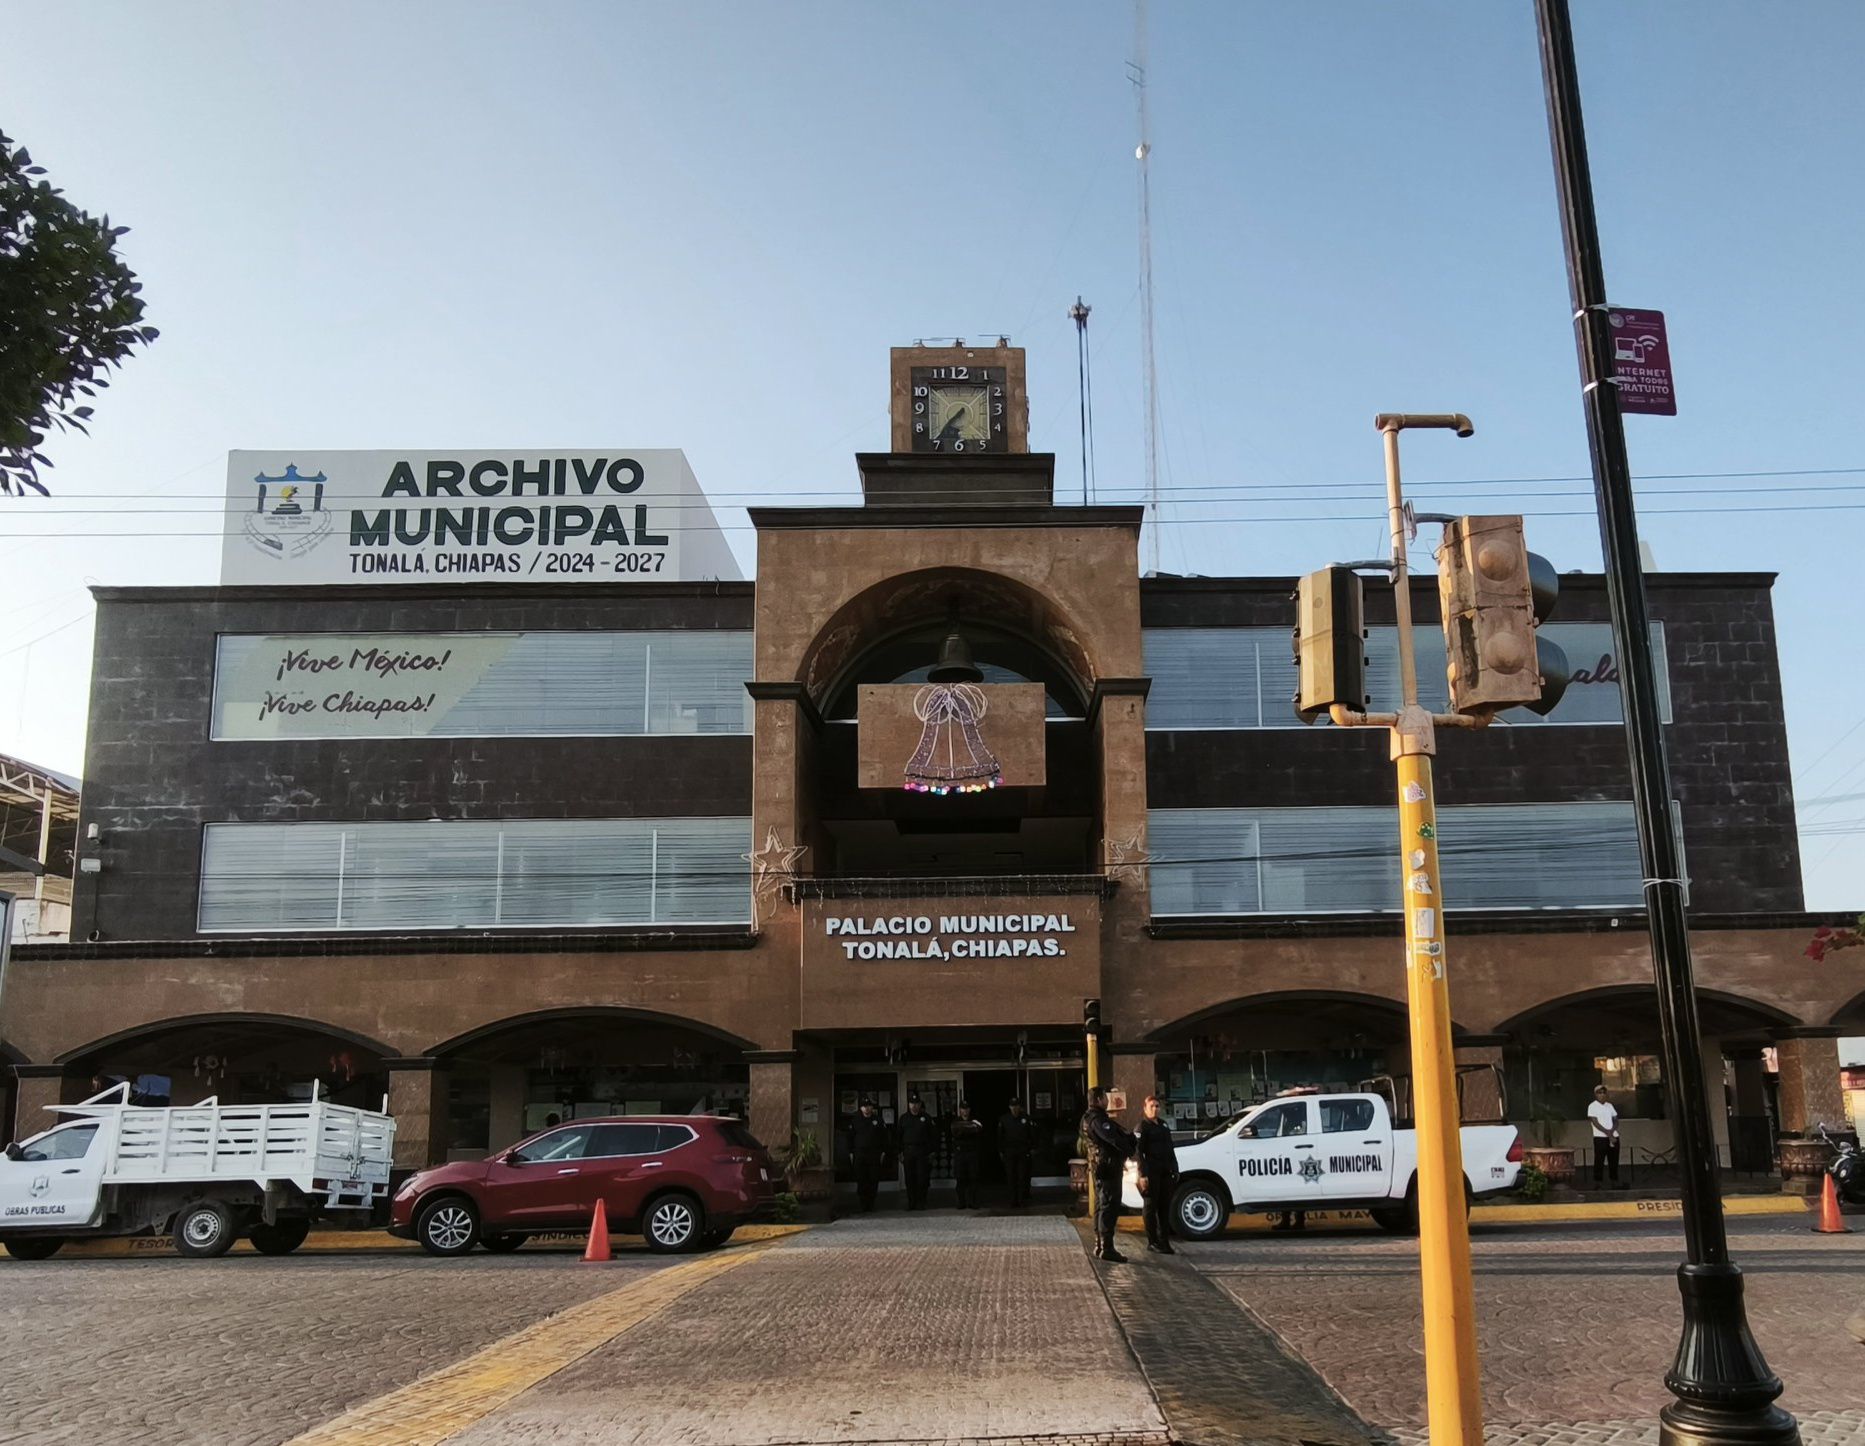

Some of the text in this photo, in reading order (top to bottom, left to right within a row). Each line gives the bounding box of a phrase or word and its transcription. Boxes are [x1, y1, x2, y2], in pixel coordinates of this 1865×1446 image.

[932, 367, 989, 380] 11 12 1
[1617, 366, 1667, 378] NTERNET
[914, 387, 928, 397] 10
[994, 386, 1002, 396] 2
[1618, 383, 1669, 395] GRATUITO
[915, 402, 925, 414] 9
[994, 403, 1003, 416] 3
[916, 422, 924, 433] 8
[994, 423, 1001, 432] 4
[933, 439, 987, 452] 7 6 5
[381, 458, 645, 498] ARCHIVO
[350, 504, 669, 546] MUNICIPAL
[350, 547, 430, 575] TONALÁ,
[435, 552, 521, 573] CHIAPAS
[528, 551, 542, 575] /
[545, 552, 595, 573] 2024
[614, 552, 666, 573] 2027
[276, 648, 452, 681] ¡Vive México!
[258, 690, 436, 721] ¡Vive Chiapas!
[825, 914, 1076, 936] PALACIO MUNICIPAL
[842, 937, 1067, 962] TONALÁ, CHIAPAS.
[1239, 1154, 1383, 1177] POLICÍA MUNICIPAL
[5, 1206, 29, 1217] OBRAS
[1637, 1201, 1684, 1212] PRESID
[128, 1238, 175, 1249] TESOR
